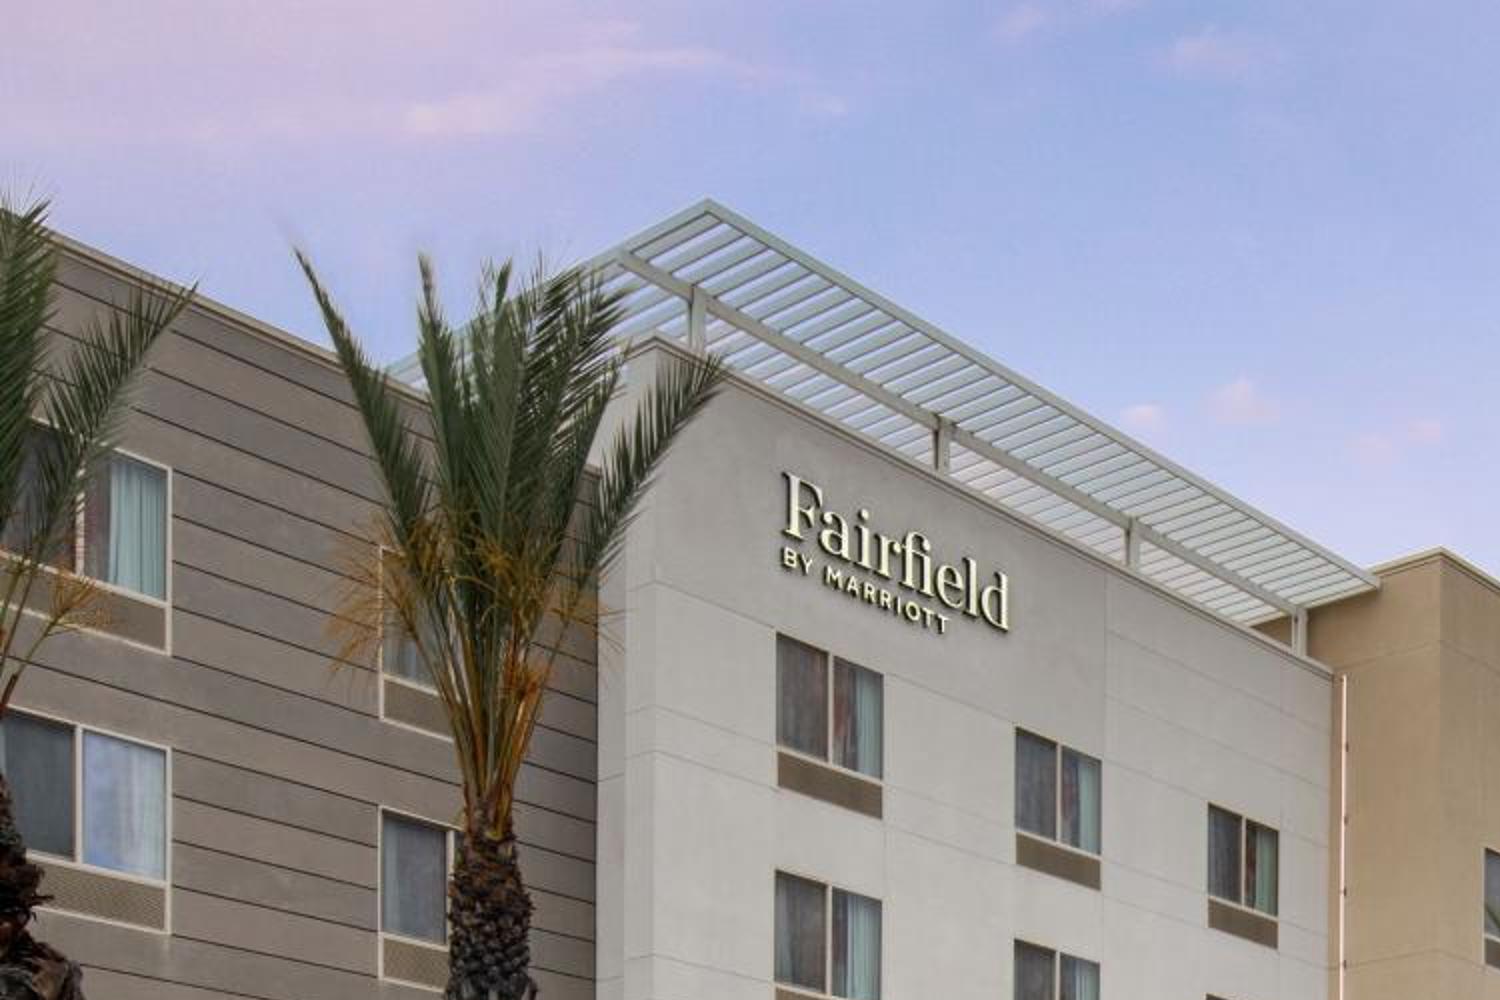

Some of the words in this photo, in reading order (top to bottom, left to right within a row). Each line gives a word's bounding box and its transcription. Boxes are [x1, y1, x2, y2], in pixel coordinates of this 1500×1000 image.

[782, 472, 1009, 631] Fairfield
[782, 546, 813, 576] BY
[824, 565, 949, 634] MARRIOTT
